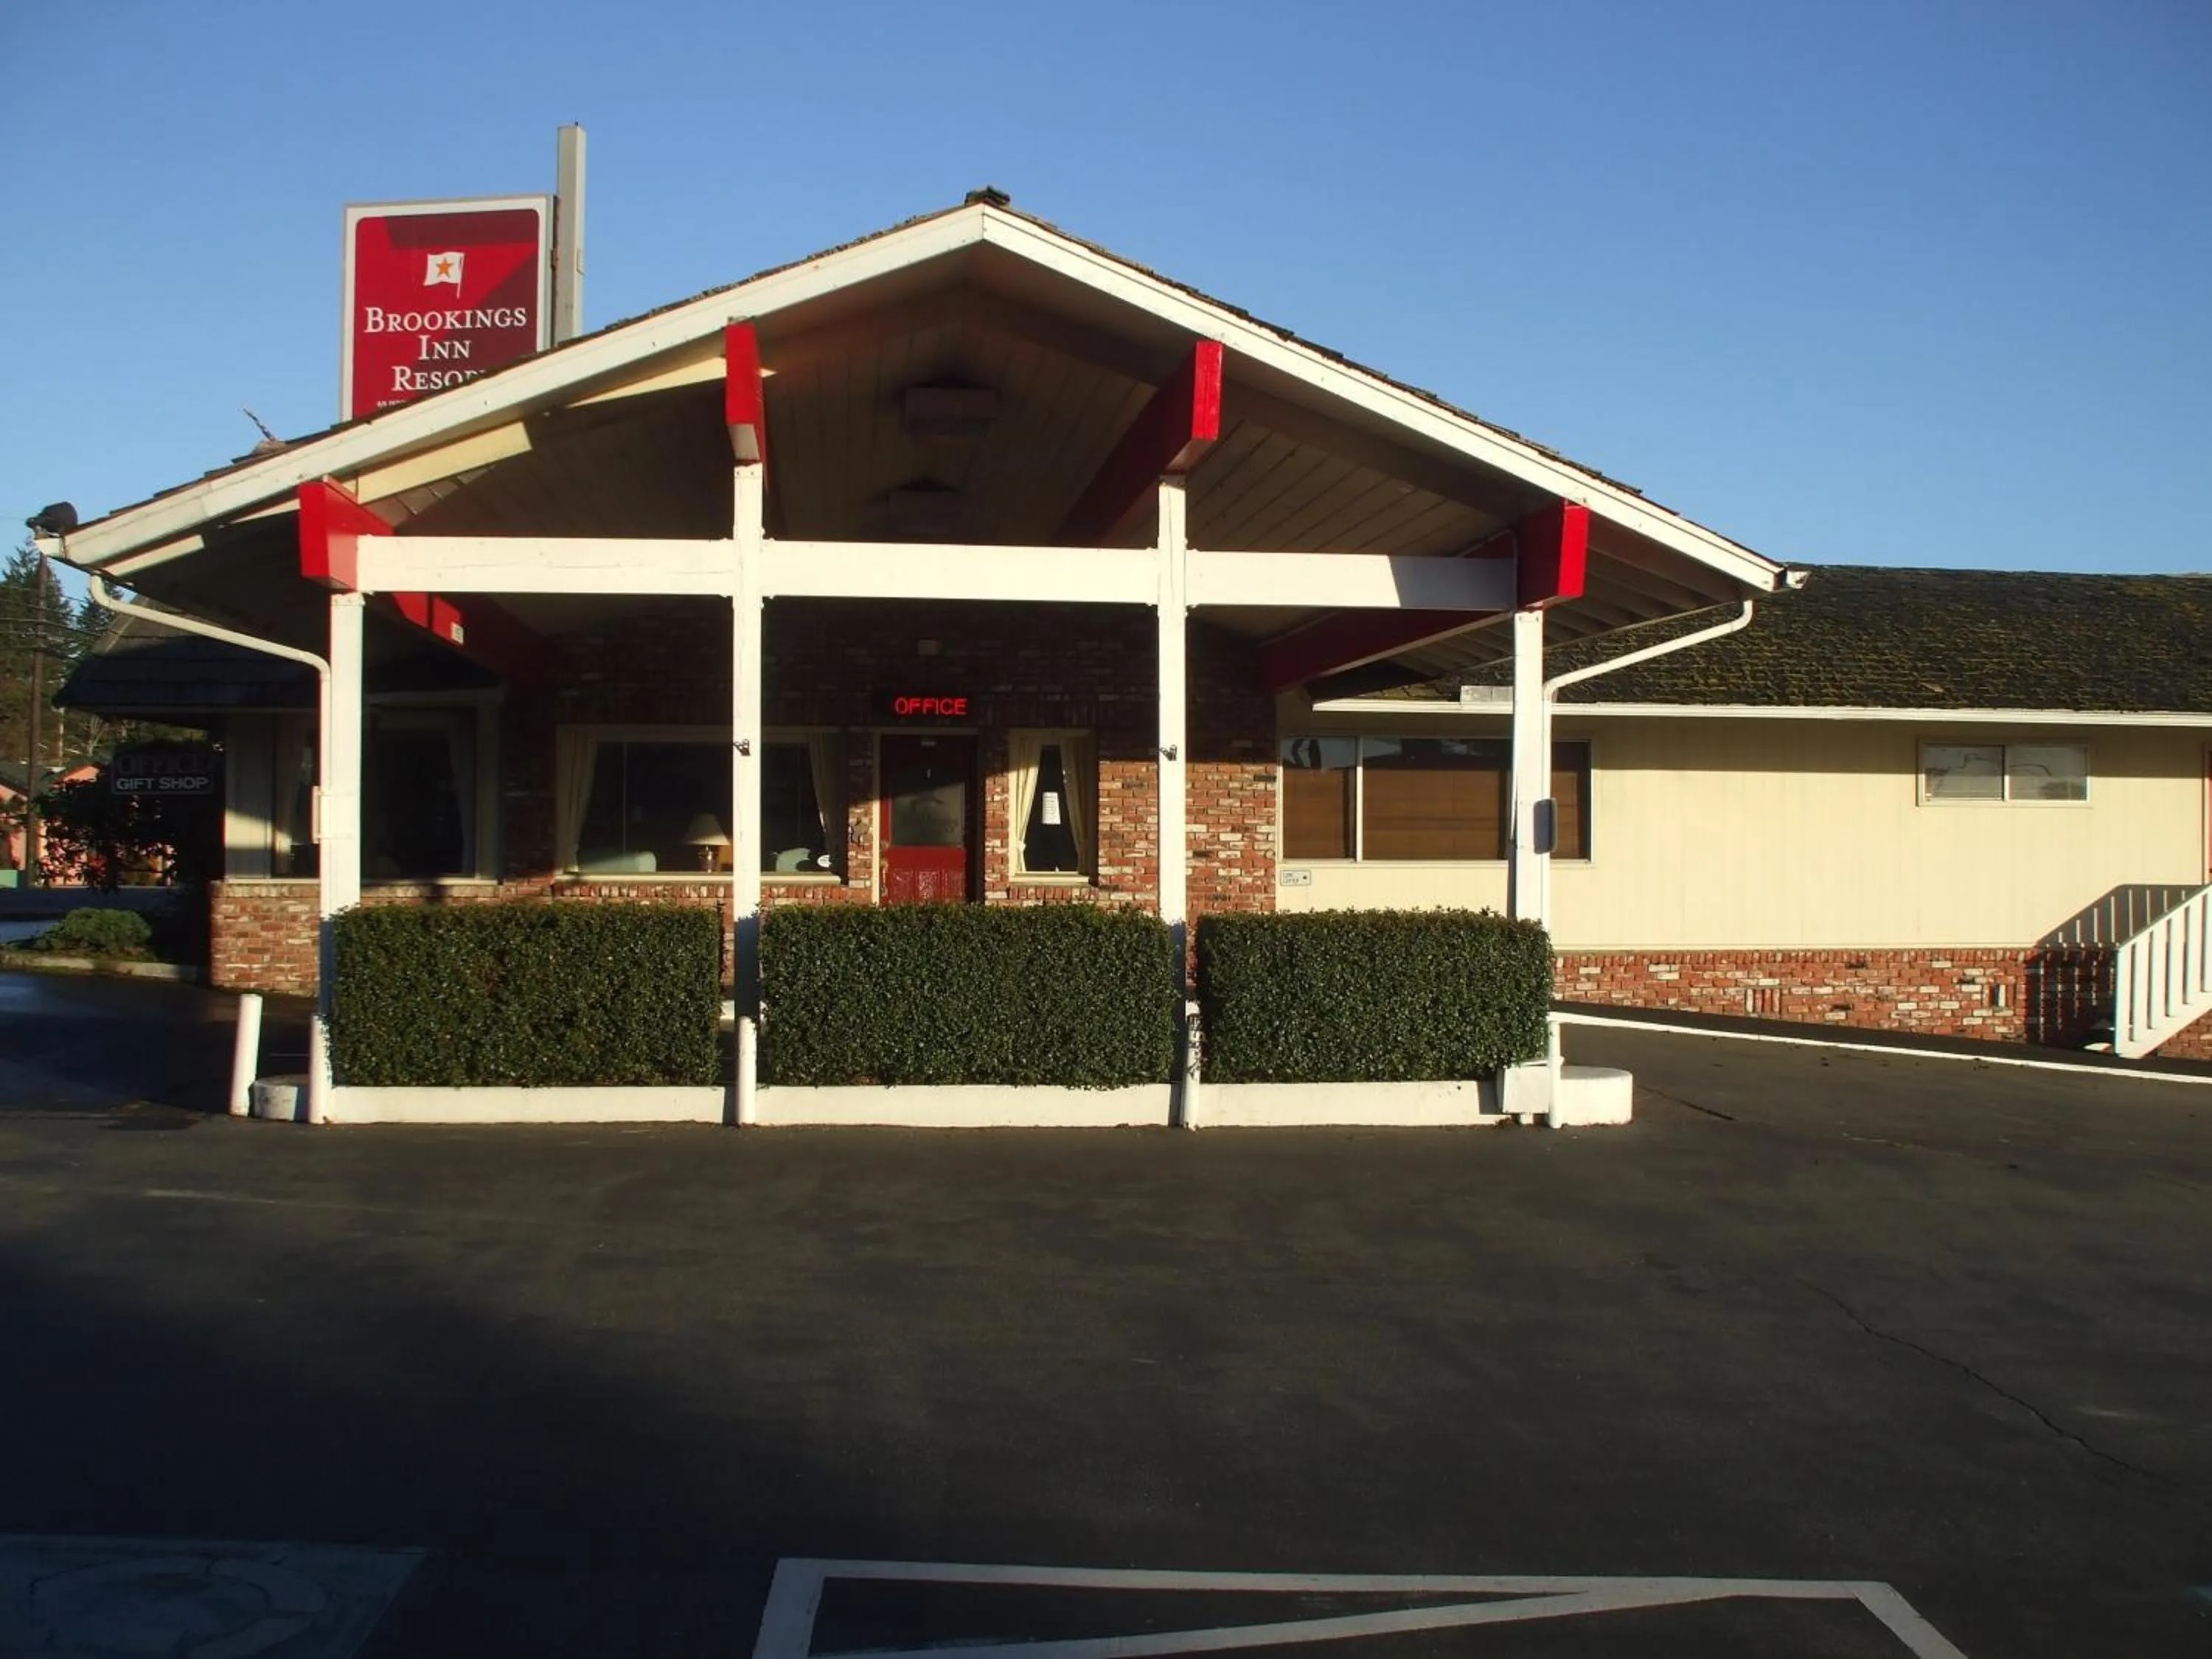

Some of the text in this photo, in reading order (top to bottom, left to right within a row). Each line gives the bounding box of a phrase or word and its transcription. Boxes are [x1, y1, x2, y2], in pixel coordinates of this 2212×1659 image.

[364, 306, 526, 333] BROOKINGS
[418, 334, 472, 360] INN
[392, 365, 487, 392] RESO
[894, 696, 968, 715] OFFICE
[116, 776, 209, 790] GIFT SHOP
